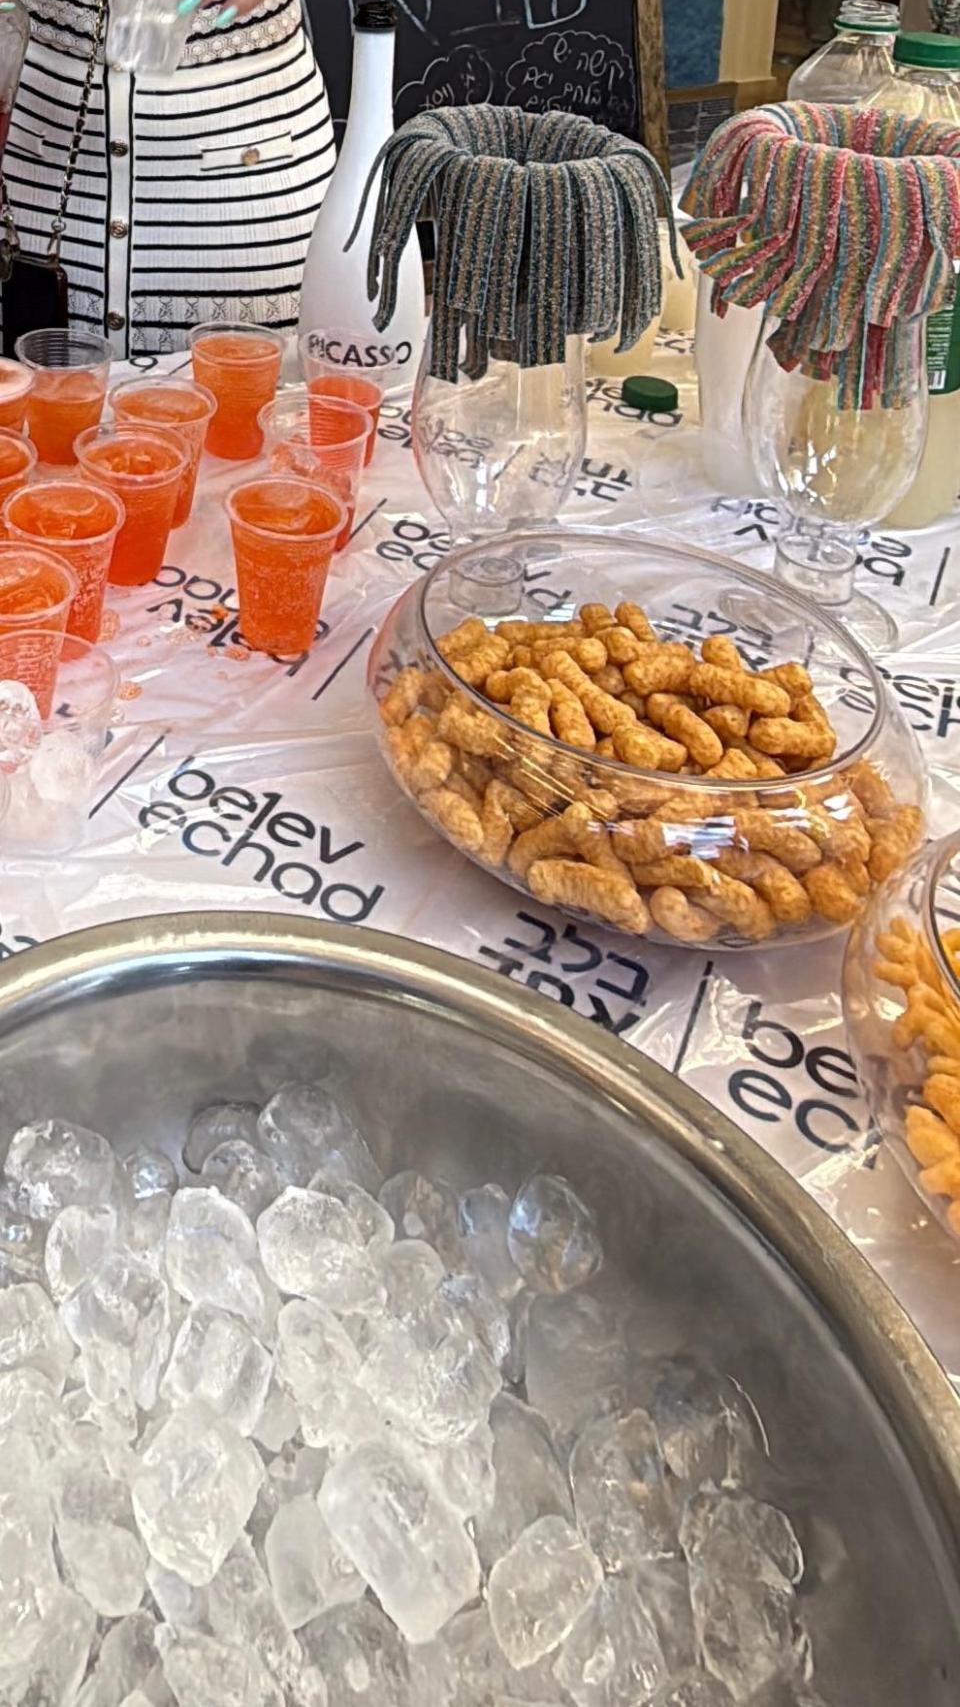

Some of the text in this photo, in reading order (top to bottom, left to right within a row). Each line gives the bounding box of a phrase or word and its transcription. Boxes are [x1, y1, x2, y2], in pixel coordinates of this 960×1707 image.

[308, 334, 412, 368] PICASSO
[167, 755, 365, 864] belev
[138, 800, 386, 923] echad
[503, 910, 651, 1007] בלב
